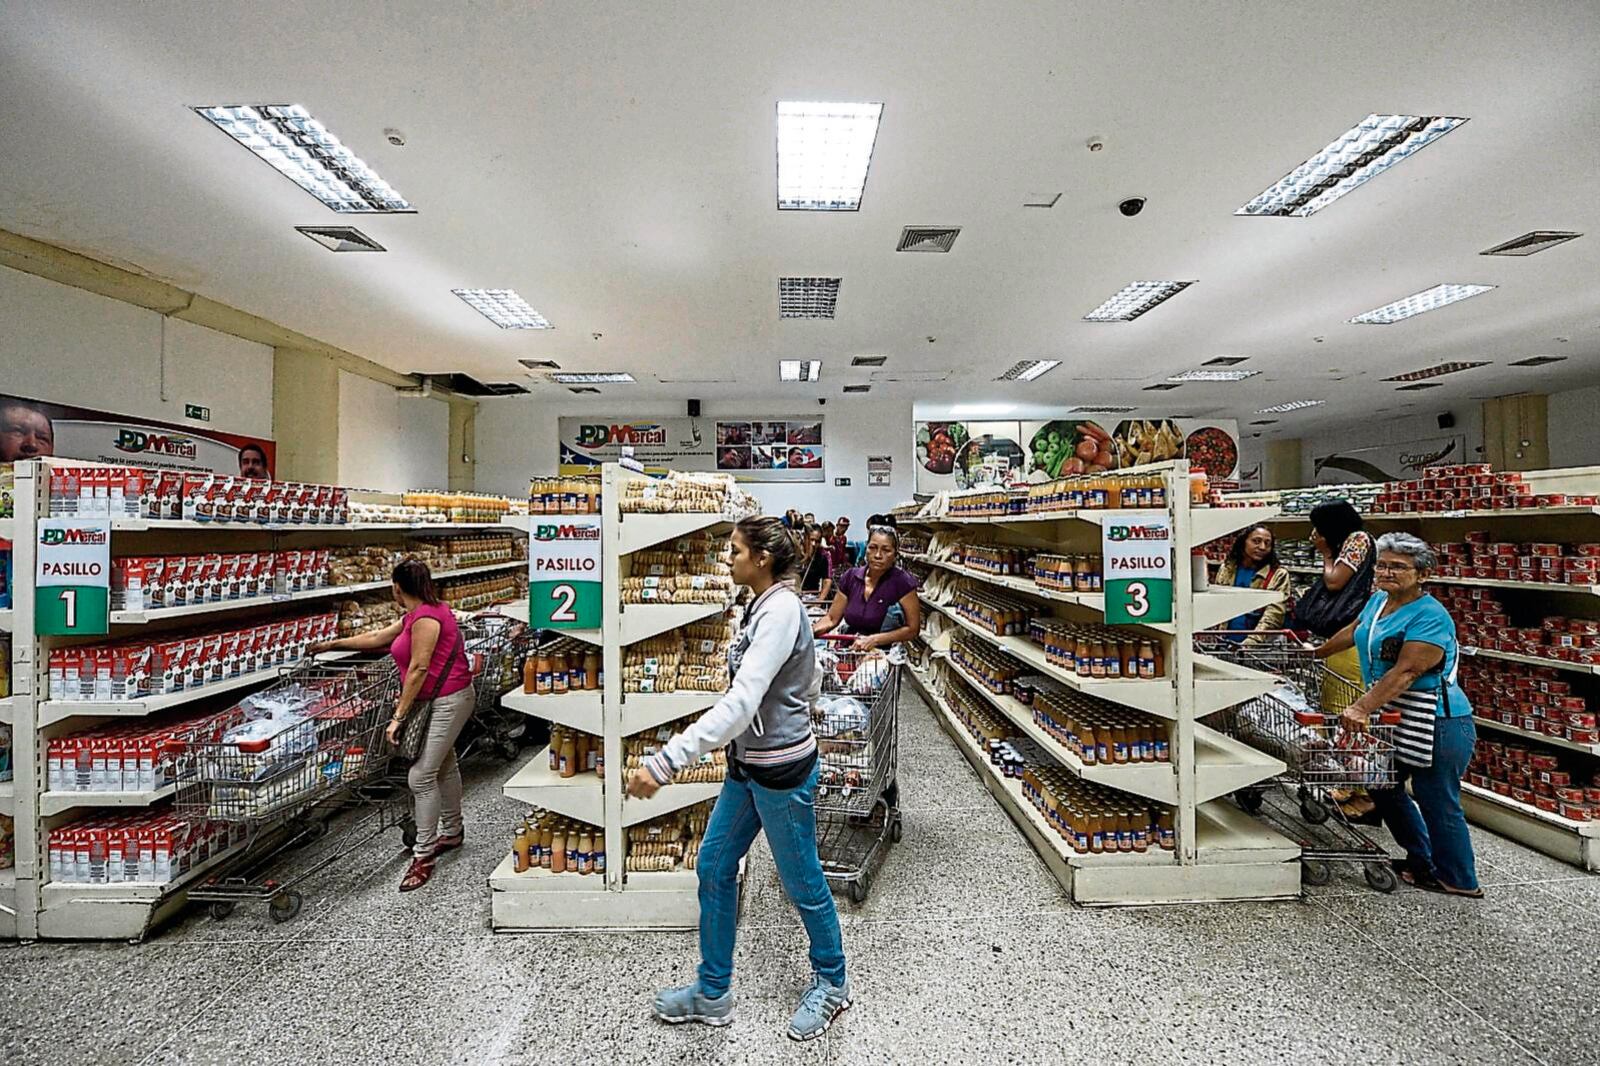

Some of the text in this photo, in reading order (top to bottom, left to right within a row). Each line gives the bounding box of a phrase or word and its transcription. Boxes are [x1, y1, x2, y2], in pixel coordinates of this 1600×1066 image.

[43, 562, 102, 577] PASILLO
[536, 557, 595, 572] PASILLO
[1111, 556, 1166, 570] PASILLO
[58, 589, 77, 628] 1
[549, 583, 578, 622] 2
[1124, 581, 1151, 618] 3
